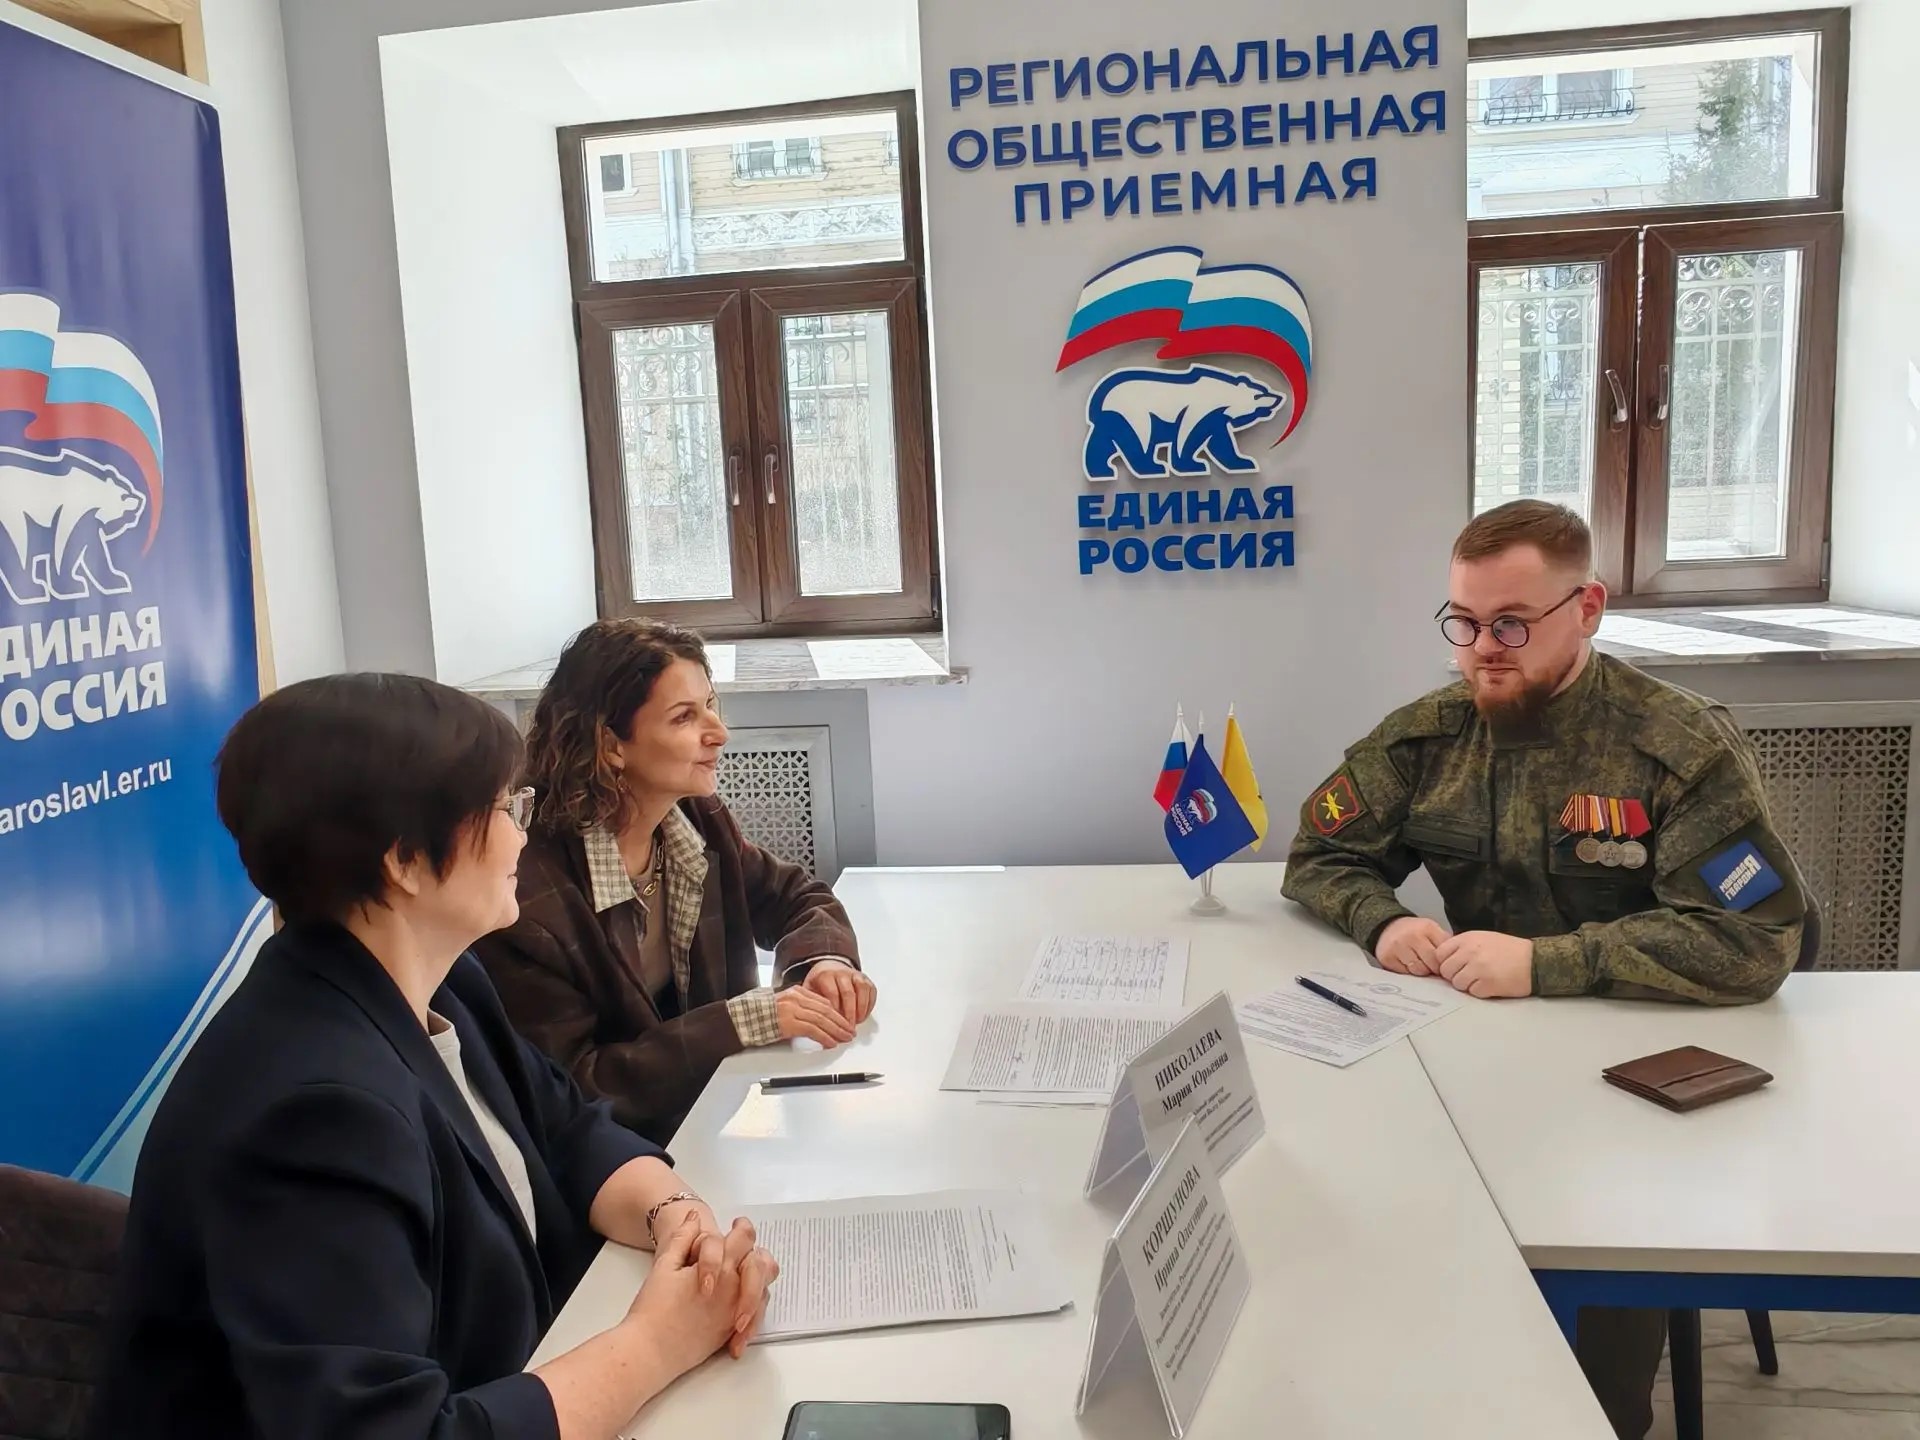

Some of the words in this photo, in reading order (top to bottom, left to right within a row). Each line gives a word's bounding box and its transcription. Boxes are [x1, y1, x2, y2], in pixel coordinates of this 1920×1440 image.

[949, 25, 1440, 109] РЕГИОНАЛЬНАЯ
[947, 90, 1446, 170] ОБЩЕСТВЕННАЯ
[1014, 157, 1378, 224] ПРИЕМНАЯ
[1078, 485, 1294, 531] ЕДИНАЯ
[1078, 531, 1295, 575] РОССИЯ
[0, 661, 167, 741] ОССИЯ
[0, 758, 172, 834] aroslavl.er.ru
[1154, 1028, 1223, 1091] НИКОЛАЕВА
[1161, 1083, 1192, 1115] Мария
[1192, 1052, 1229, 1088] Юрьевна
[1142, 1164, 1201, 1265] КОРШУНОВА
[1154, 1247, 1180, 1292] Ирина
[1177, 1195, 1208, 1250] Олеговна
